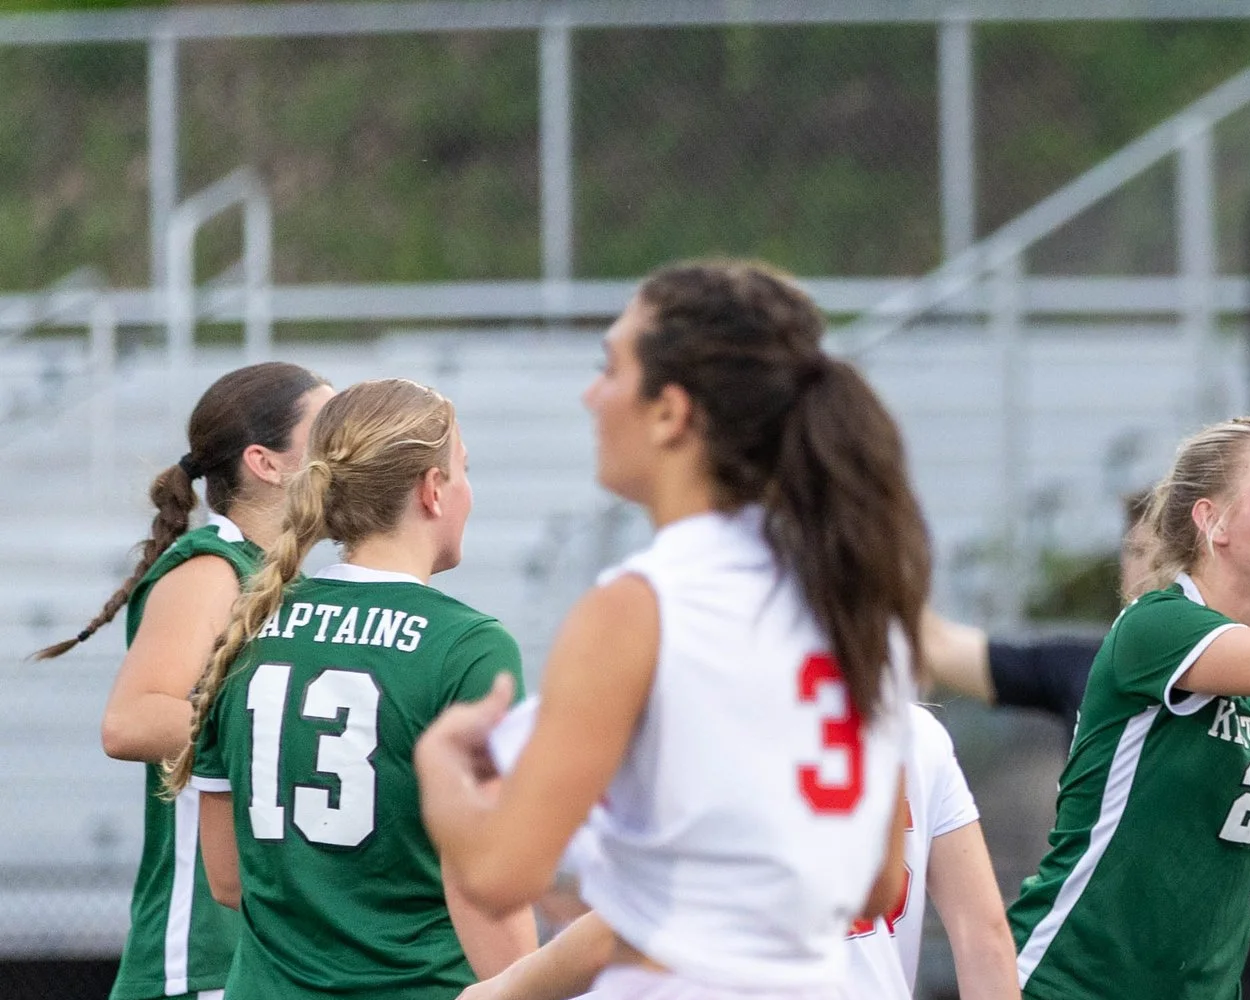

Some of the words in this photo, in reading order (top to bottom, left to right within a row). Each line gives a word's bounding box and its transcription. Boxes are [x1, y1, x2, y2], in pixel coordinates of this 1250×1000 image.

[258, 602, 428, 652] APTAINS
[246, 663, 381, 849] 13
[796, 653, 866, 817] 3
